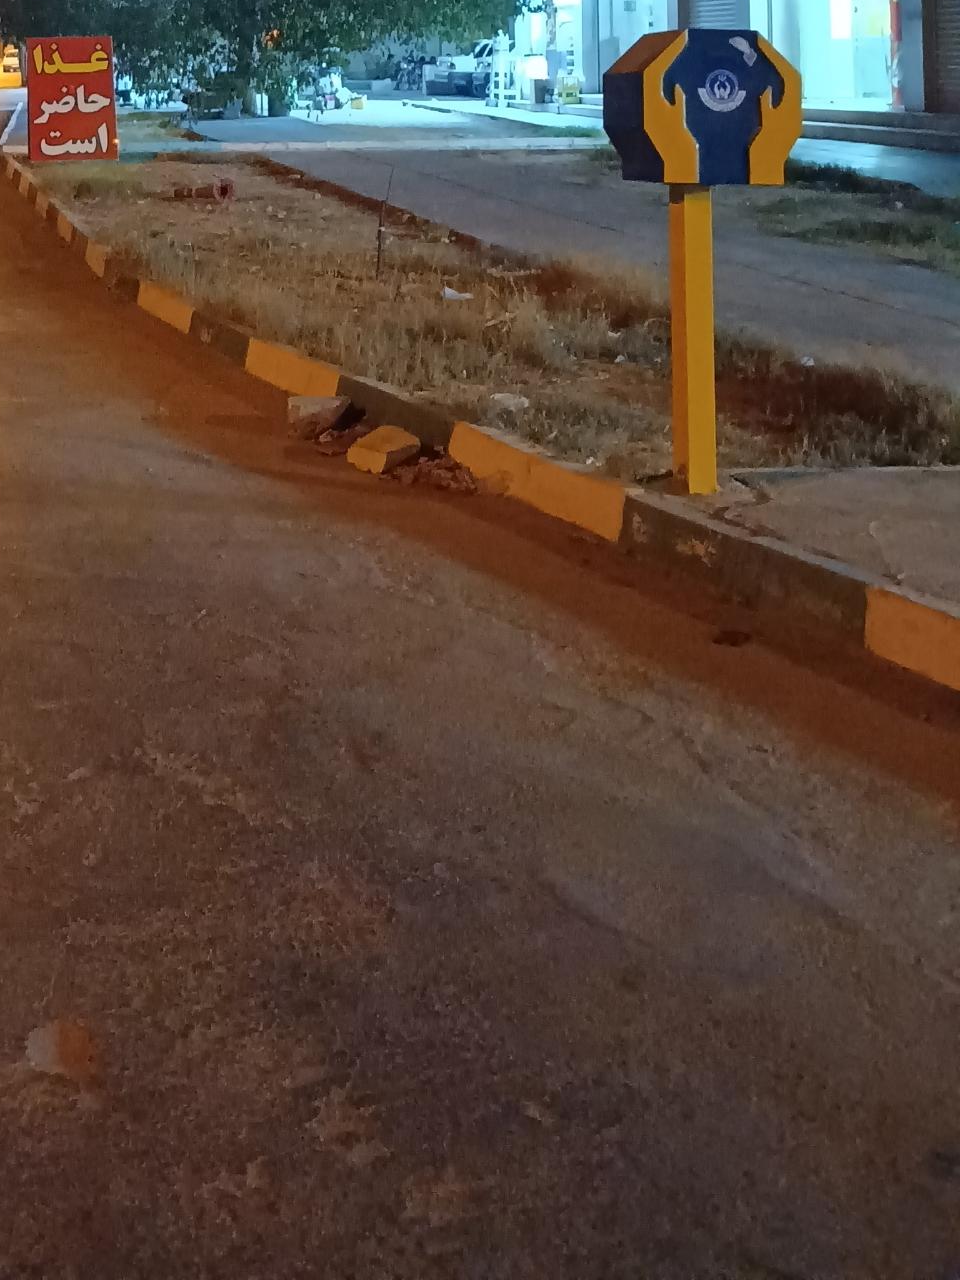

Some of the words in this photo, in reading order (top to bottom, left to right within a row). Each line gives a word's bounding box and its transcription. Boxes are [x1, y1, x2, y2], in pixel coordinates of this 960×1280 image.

[32, 42, 110, 75] غذا
[33, 84, 111, 124] حاضر
[40, 122, 108, 156] است
